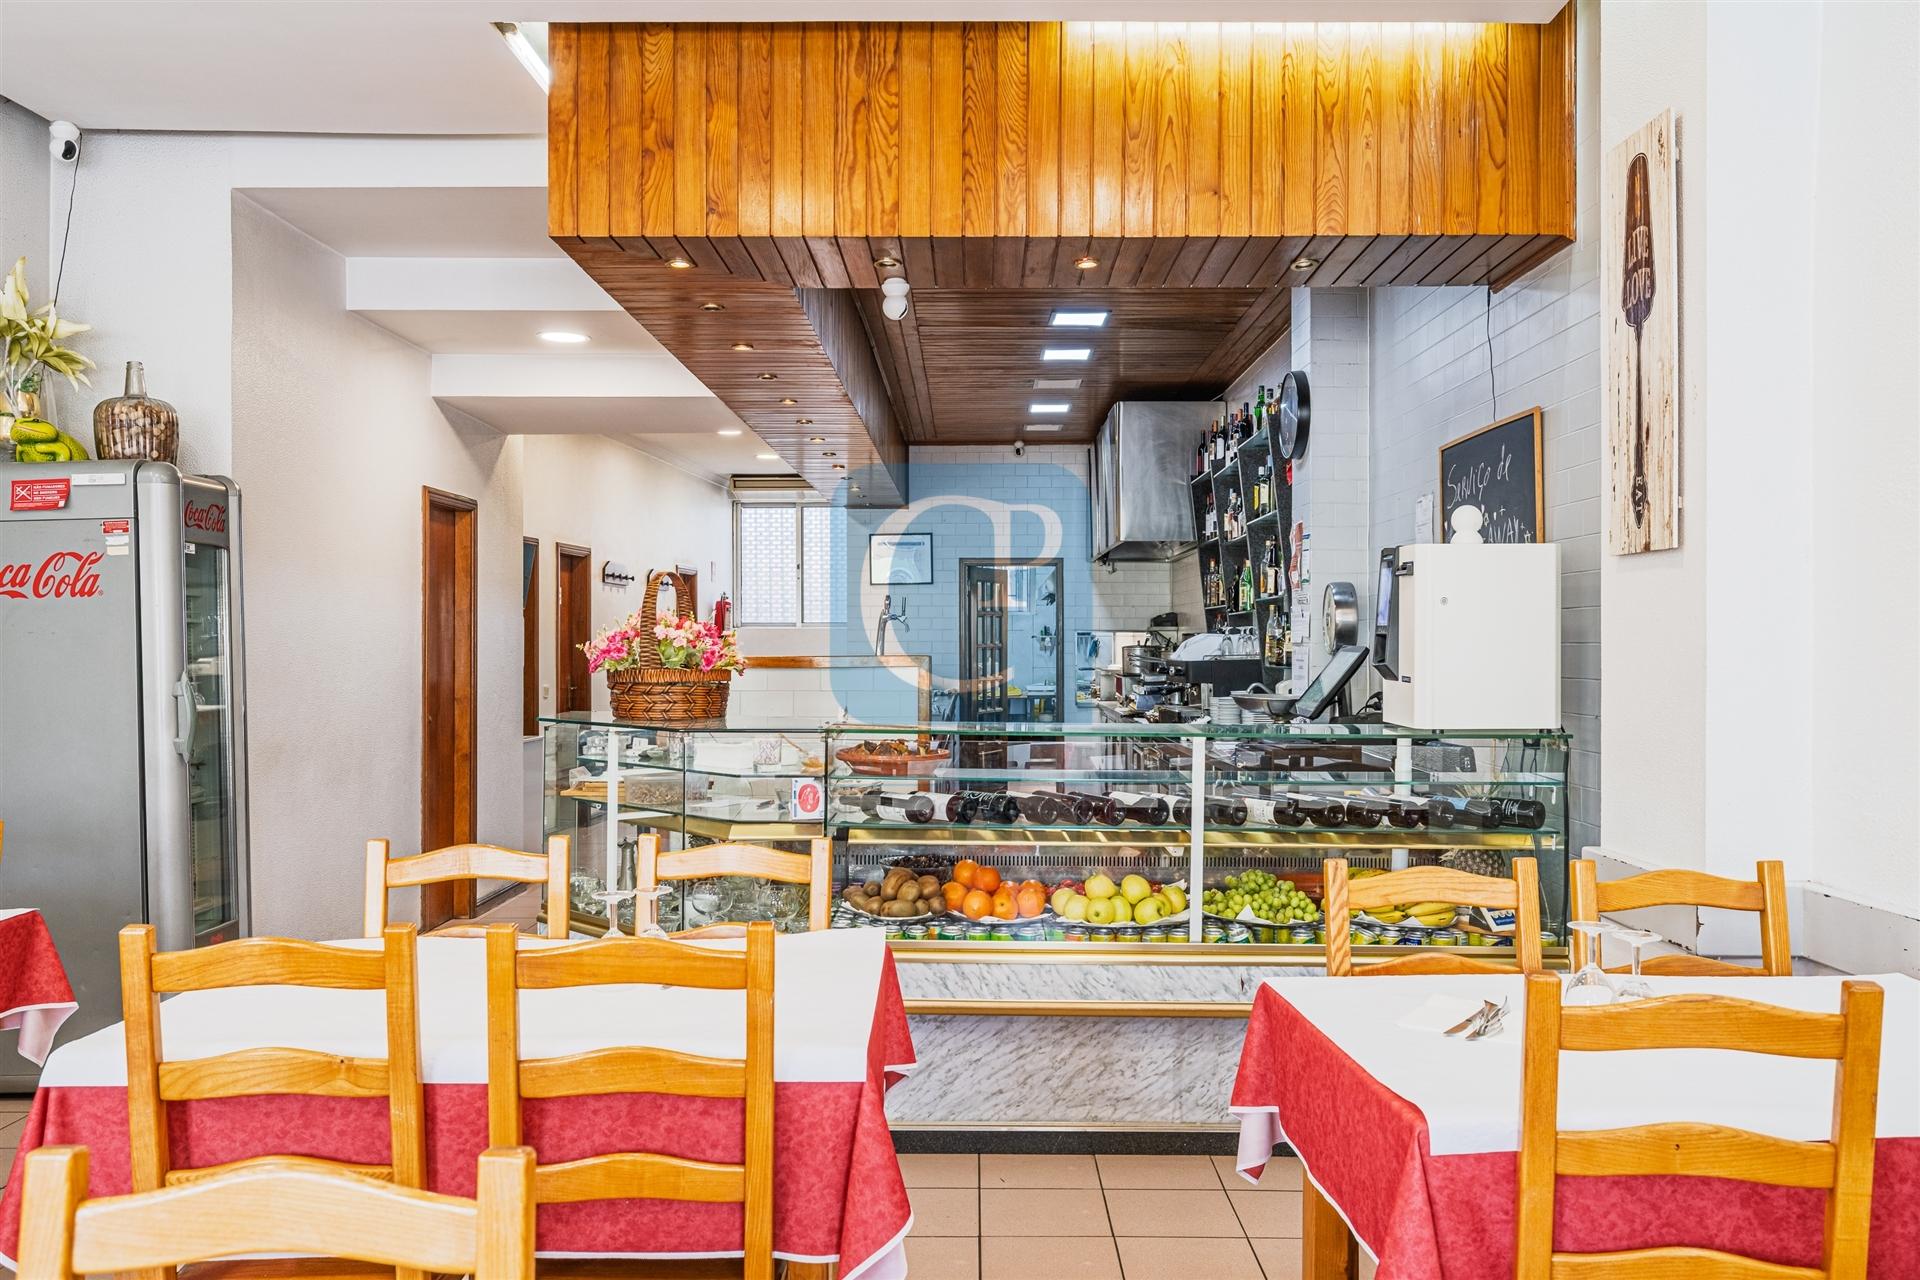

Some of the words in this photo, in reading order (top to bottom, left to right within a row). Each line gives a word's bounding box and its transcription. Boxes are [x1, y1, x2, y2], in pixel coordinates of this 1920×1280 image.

[1627, 225, 1649, 270] LIVE
[1625, 267, 1651, 310] LOVE
[1496, 443, 1512, 482] de
[1635, 475, 1644, 514] EAT
